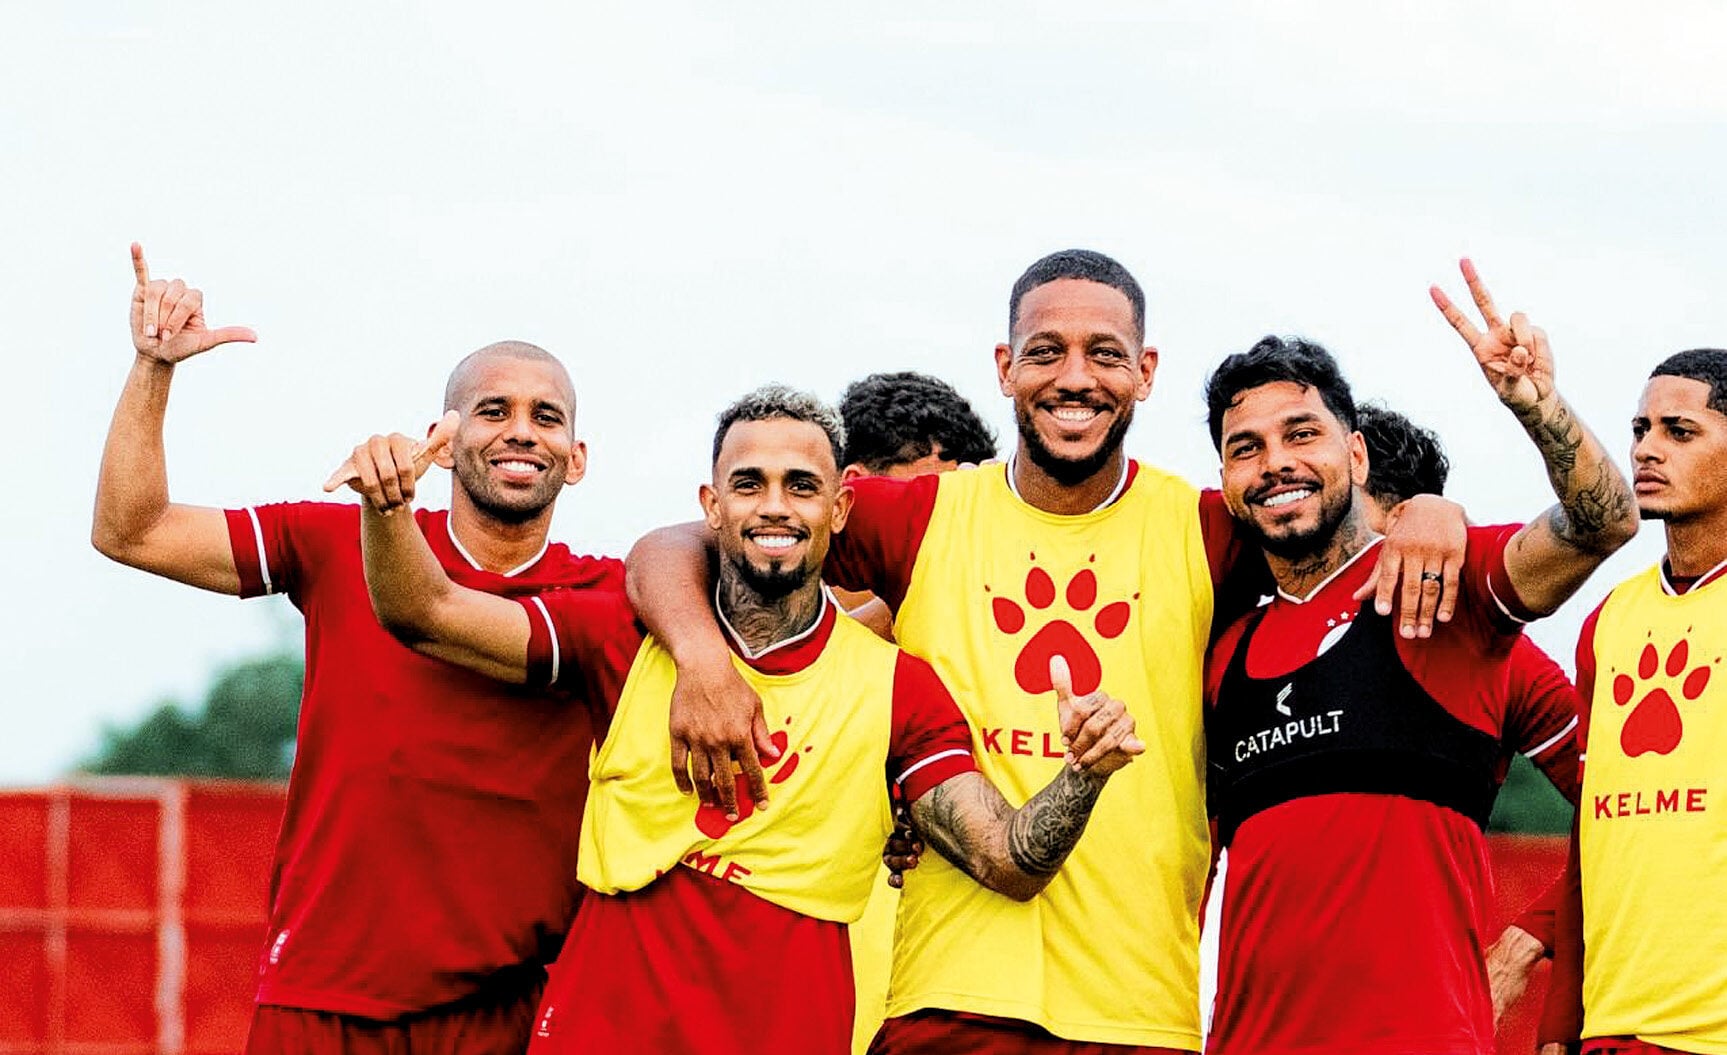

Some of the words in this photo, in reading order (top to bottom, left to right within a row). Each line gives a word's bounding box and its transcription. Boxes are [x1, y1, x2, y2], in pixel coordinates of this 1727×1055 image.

[982, 728, 1065, 758] KEL
[1235, 710, 1343, 762] CATAPULT
[1595, 789, 1707, 819] KELME
